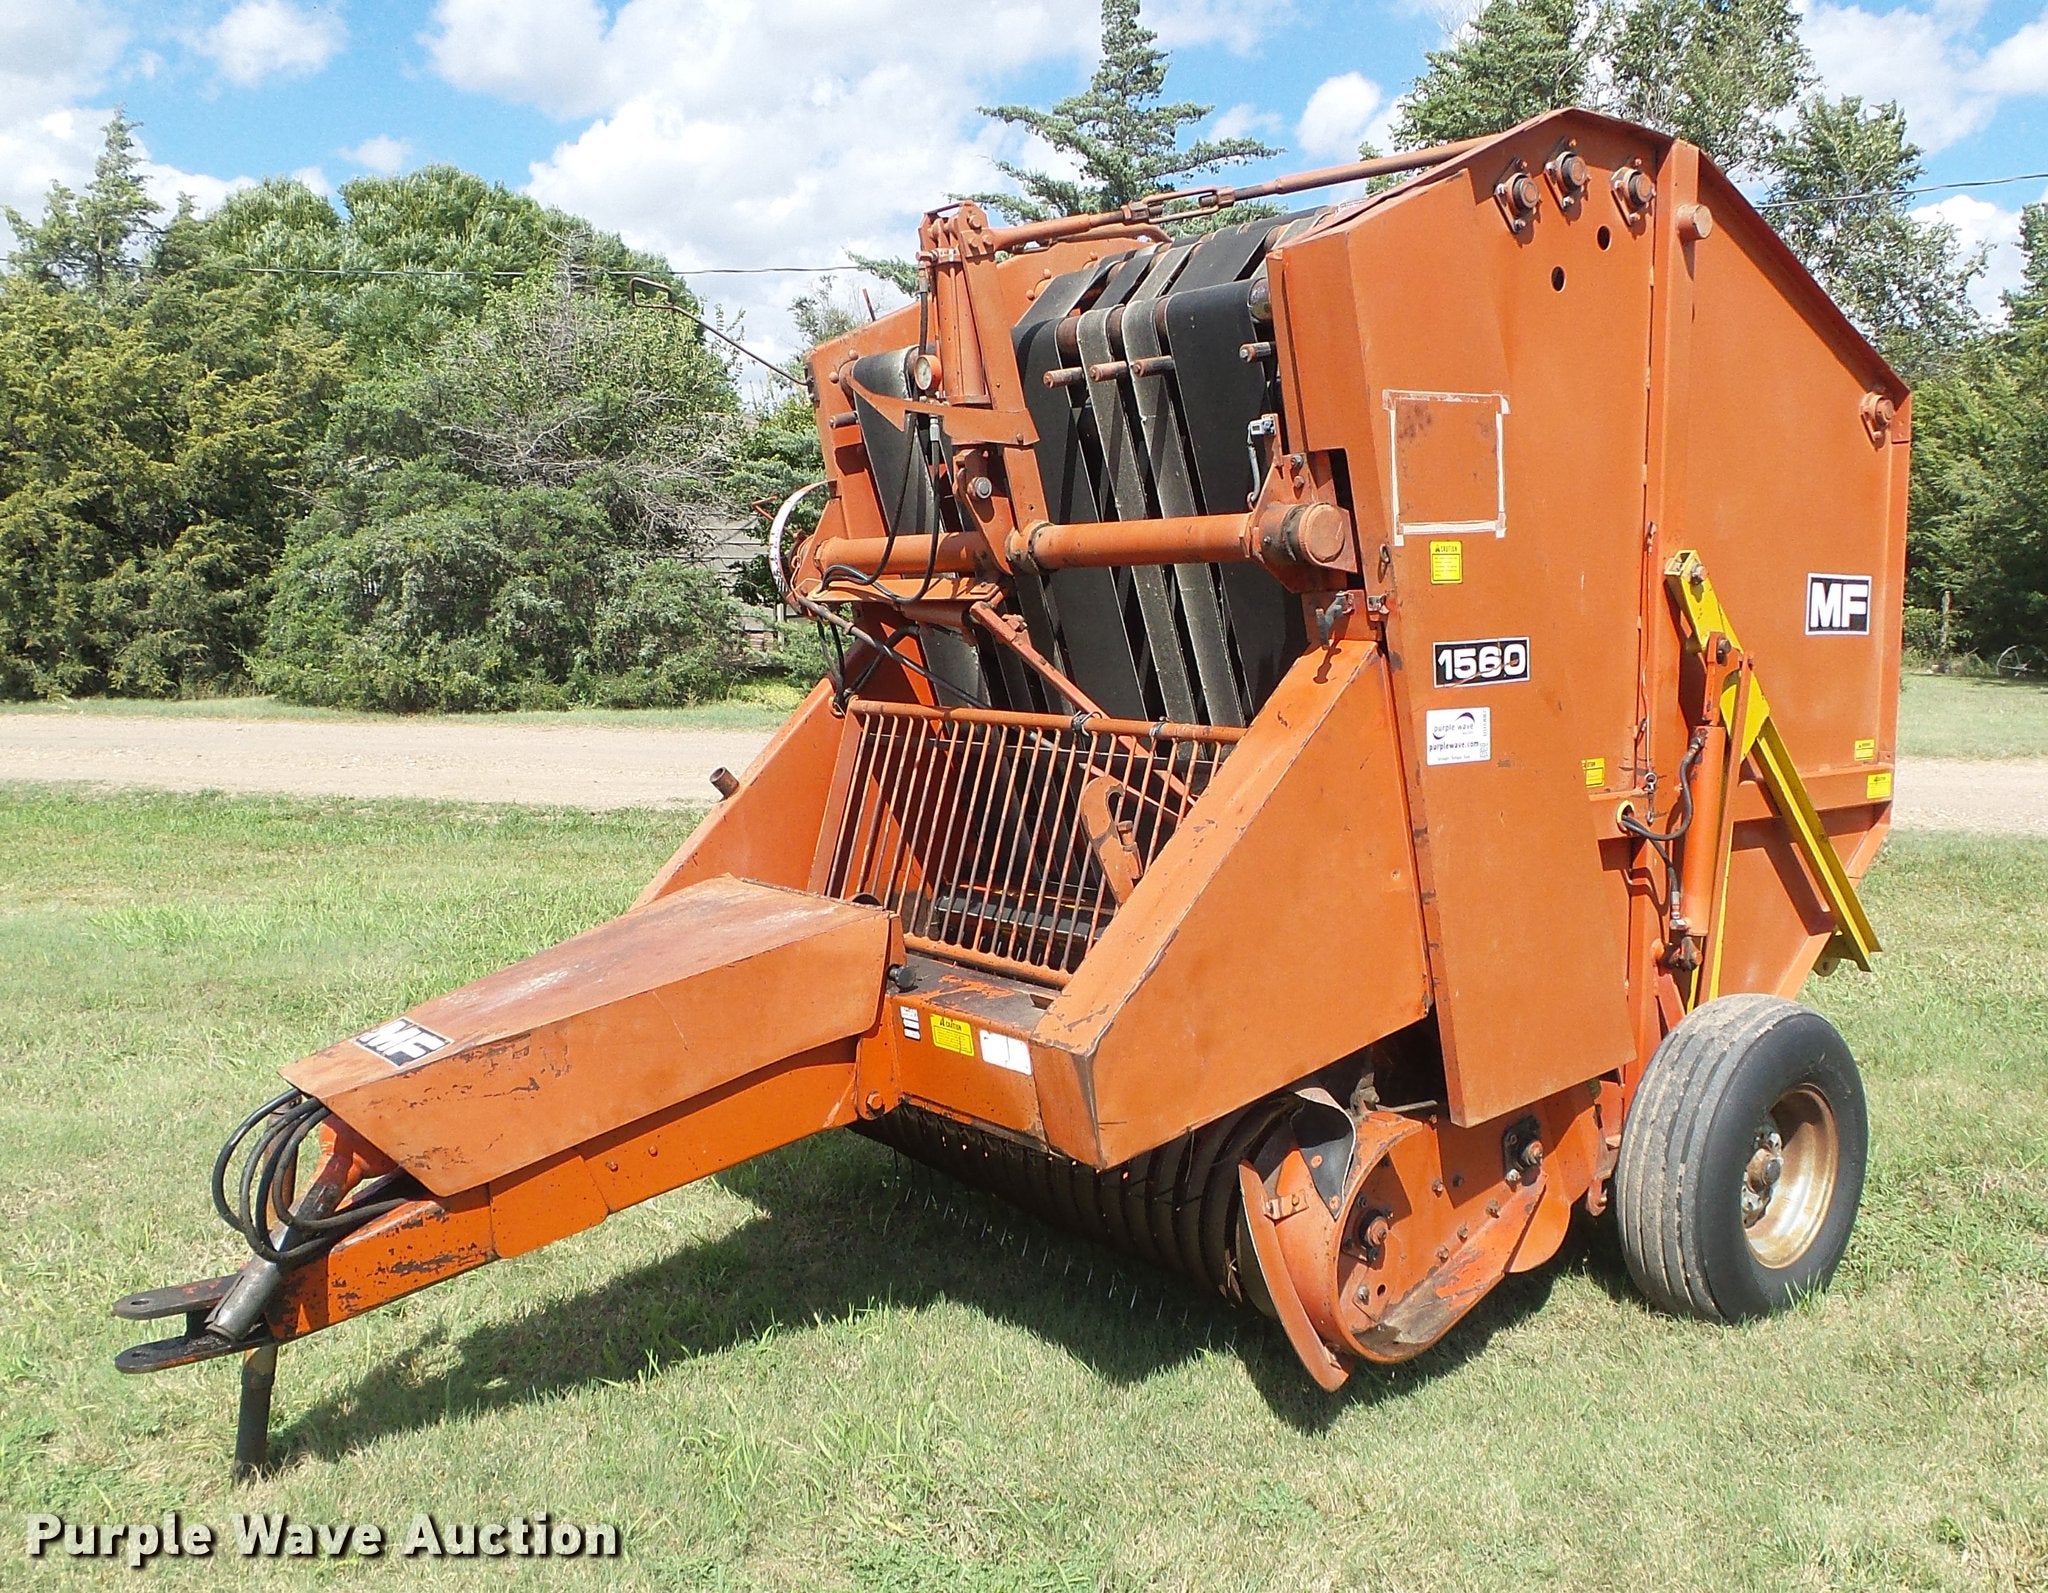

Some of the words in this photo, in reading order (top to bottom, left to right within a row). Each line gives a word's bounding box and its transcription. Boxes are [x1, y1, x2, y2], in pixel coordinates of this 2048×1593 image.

[1810, 582, 1868, 628] MF
[1437, 643, 1526, 681] 1560
[1429, 741, 1479, 752] purplewave.com
[1434, 723, 1455, 732] purple
[359, 1020, 446, 1059] MF
